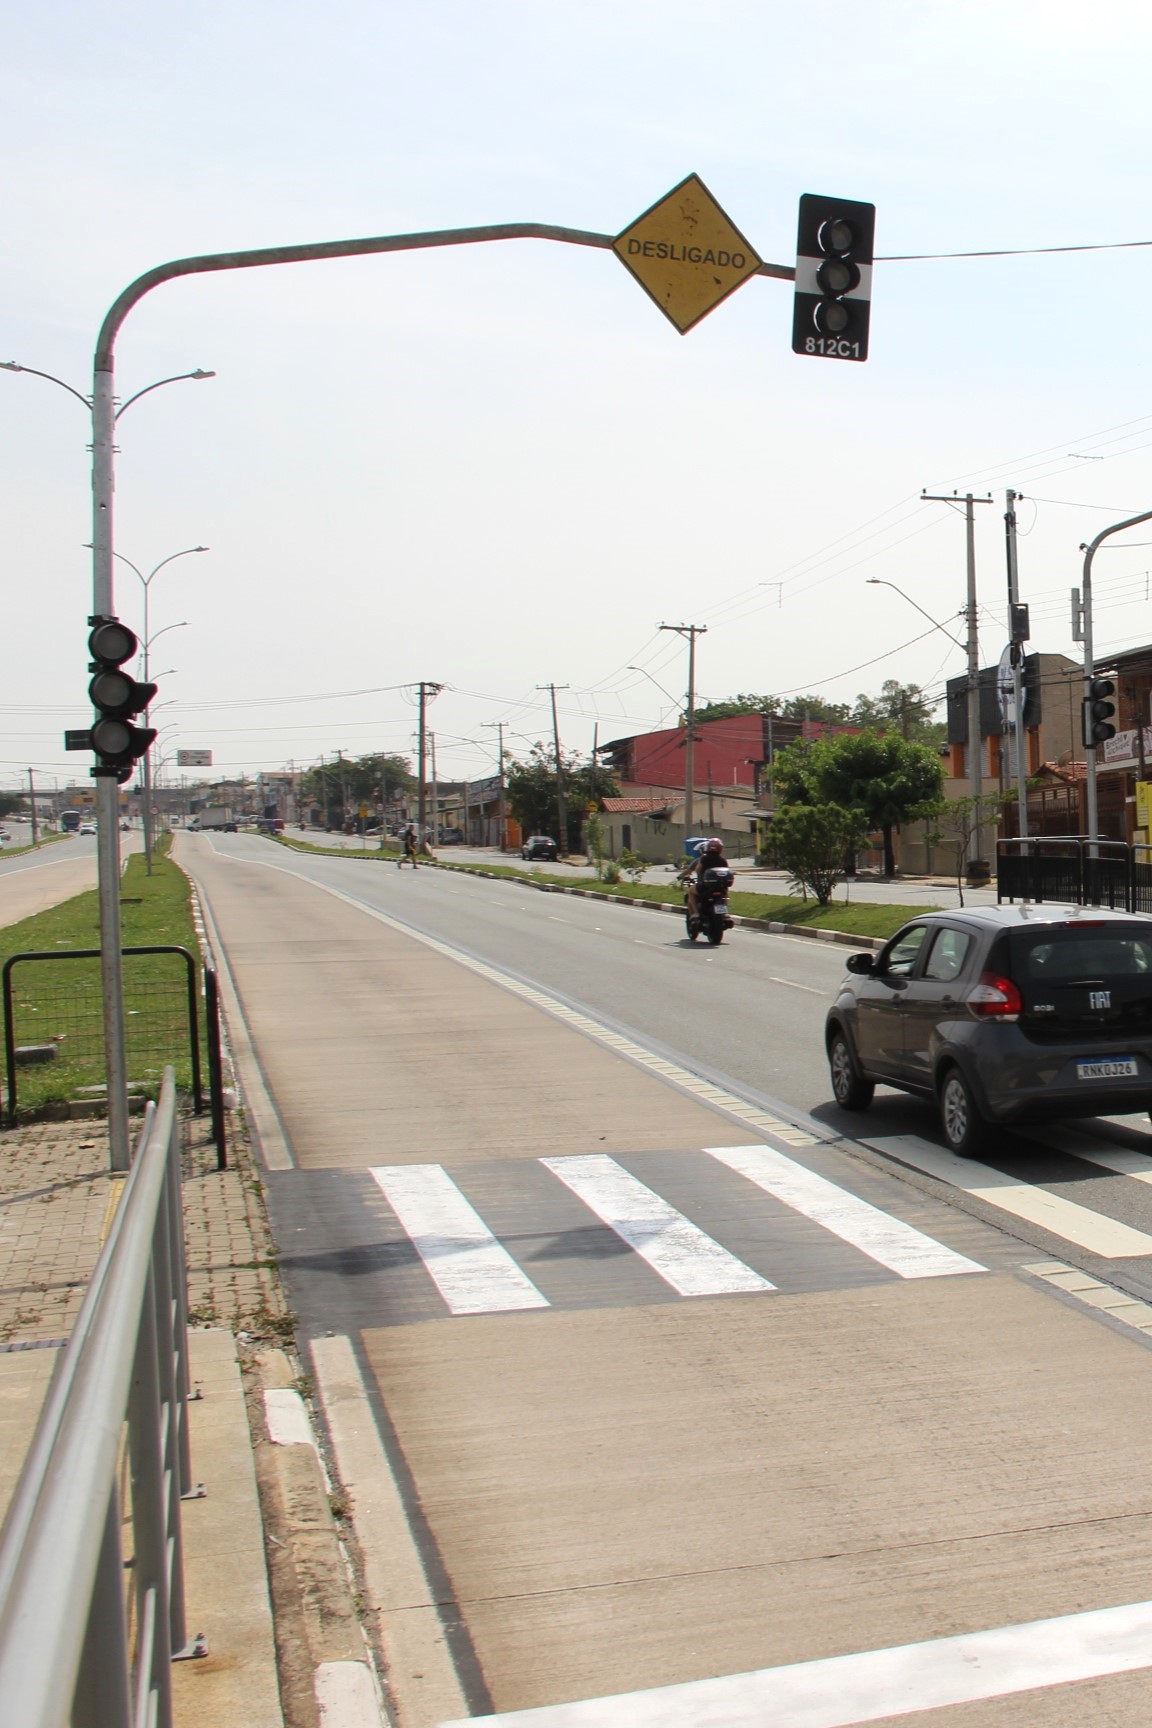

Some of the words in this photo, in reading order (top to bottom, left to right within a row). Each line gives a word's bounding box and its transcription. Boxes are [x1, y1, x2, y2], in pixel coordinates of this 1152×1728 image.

[627, 238, 746, 270] DESLIGADO
[804, 336, 861, 359] 812C1
[1089, 991, 1112, 1009] FIAT
